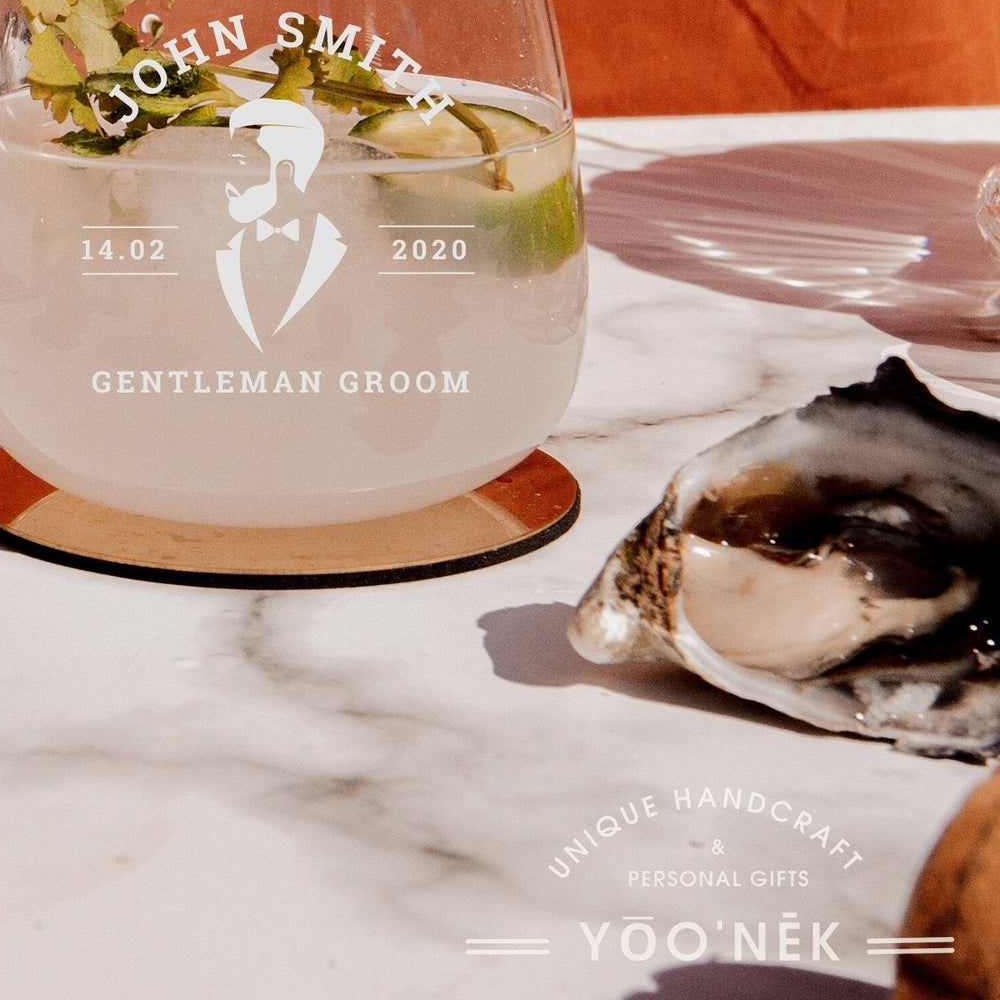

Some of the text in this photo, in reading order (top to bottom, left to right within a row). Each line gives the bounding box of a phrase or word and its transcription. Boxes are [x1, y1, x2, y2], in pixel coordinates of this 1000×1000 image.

[109, 11, 455, 126] JOHN SMITH
[81, 238, 166, 261] 14.02
[392, 238, 468, 261] 2020
[92, 370, 470, 394] GENTLEMAN GROOM
